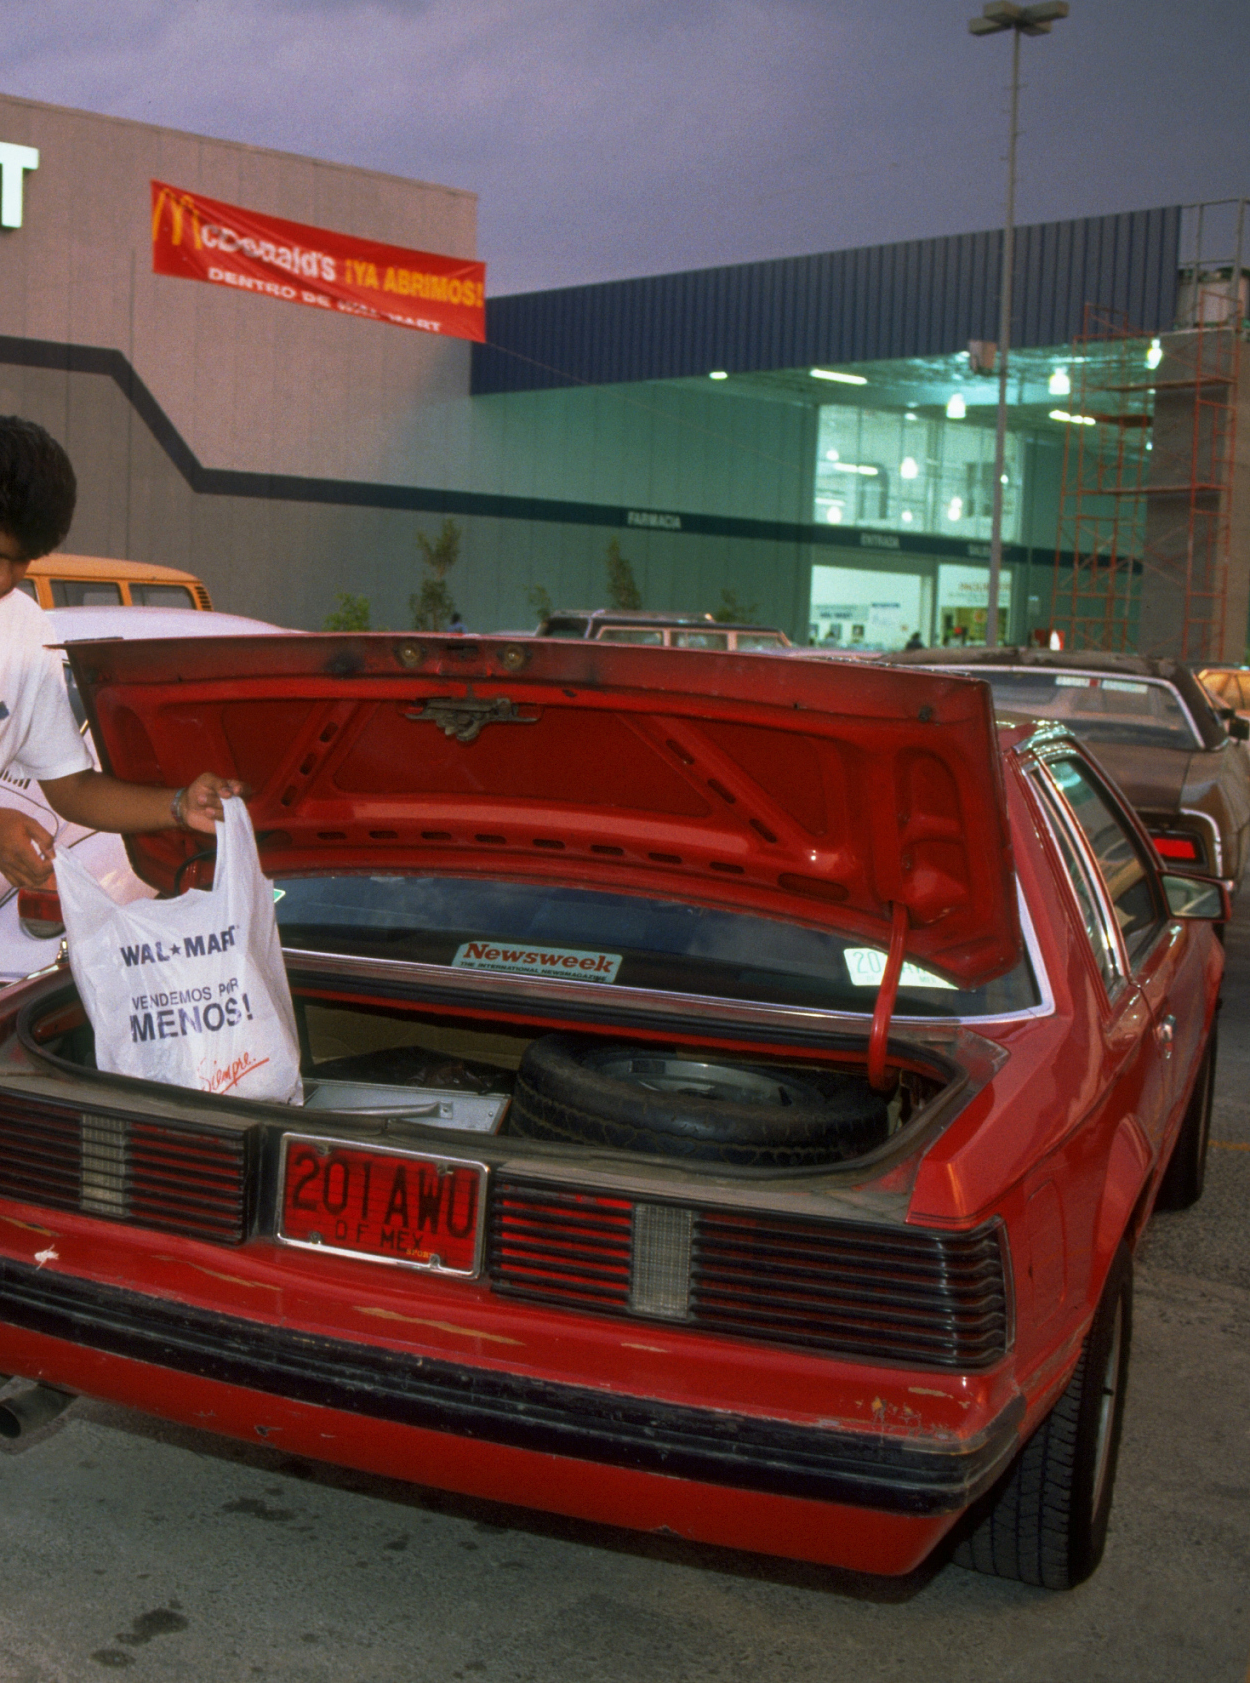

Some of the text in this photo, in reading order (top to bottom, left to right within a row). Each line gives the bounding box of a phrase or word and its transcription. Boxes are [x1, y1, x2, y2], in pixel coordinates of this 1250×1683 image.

[208, 267, 296, 298] DENTRO
[383, 266, 484, 308] ABRIMOS!
[627, 509, 682, 530] FARMACIA
[463, 942, 615, 974] Newsweek
[478, 962, 539, 974] INTERNATIONAL
[131, 986, 213, 1011] VENDEMOS
[129, 992, 254, 1043] MENOS!
[379, 1226, 425, 1251] MEX
